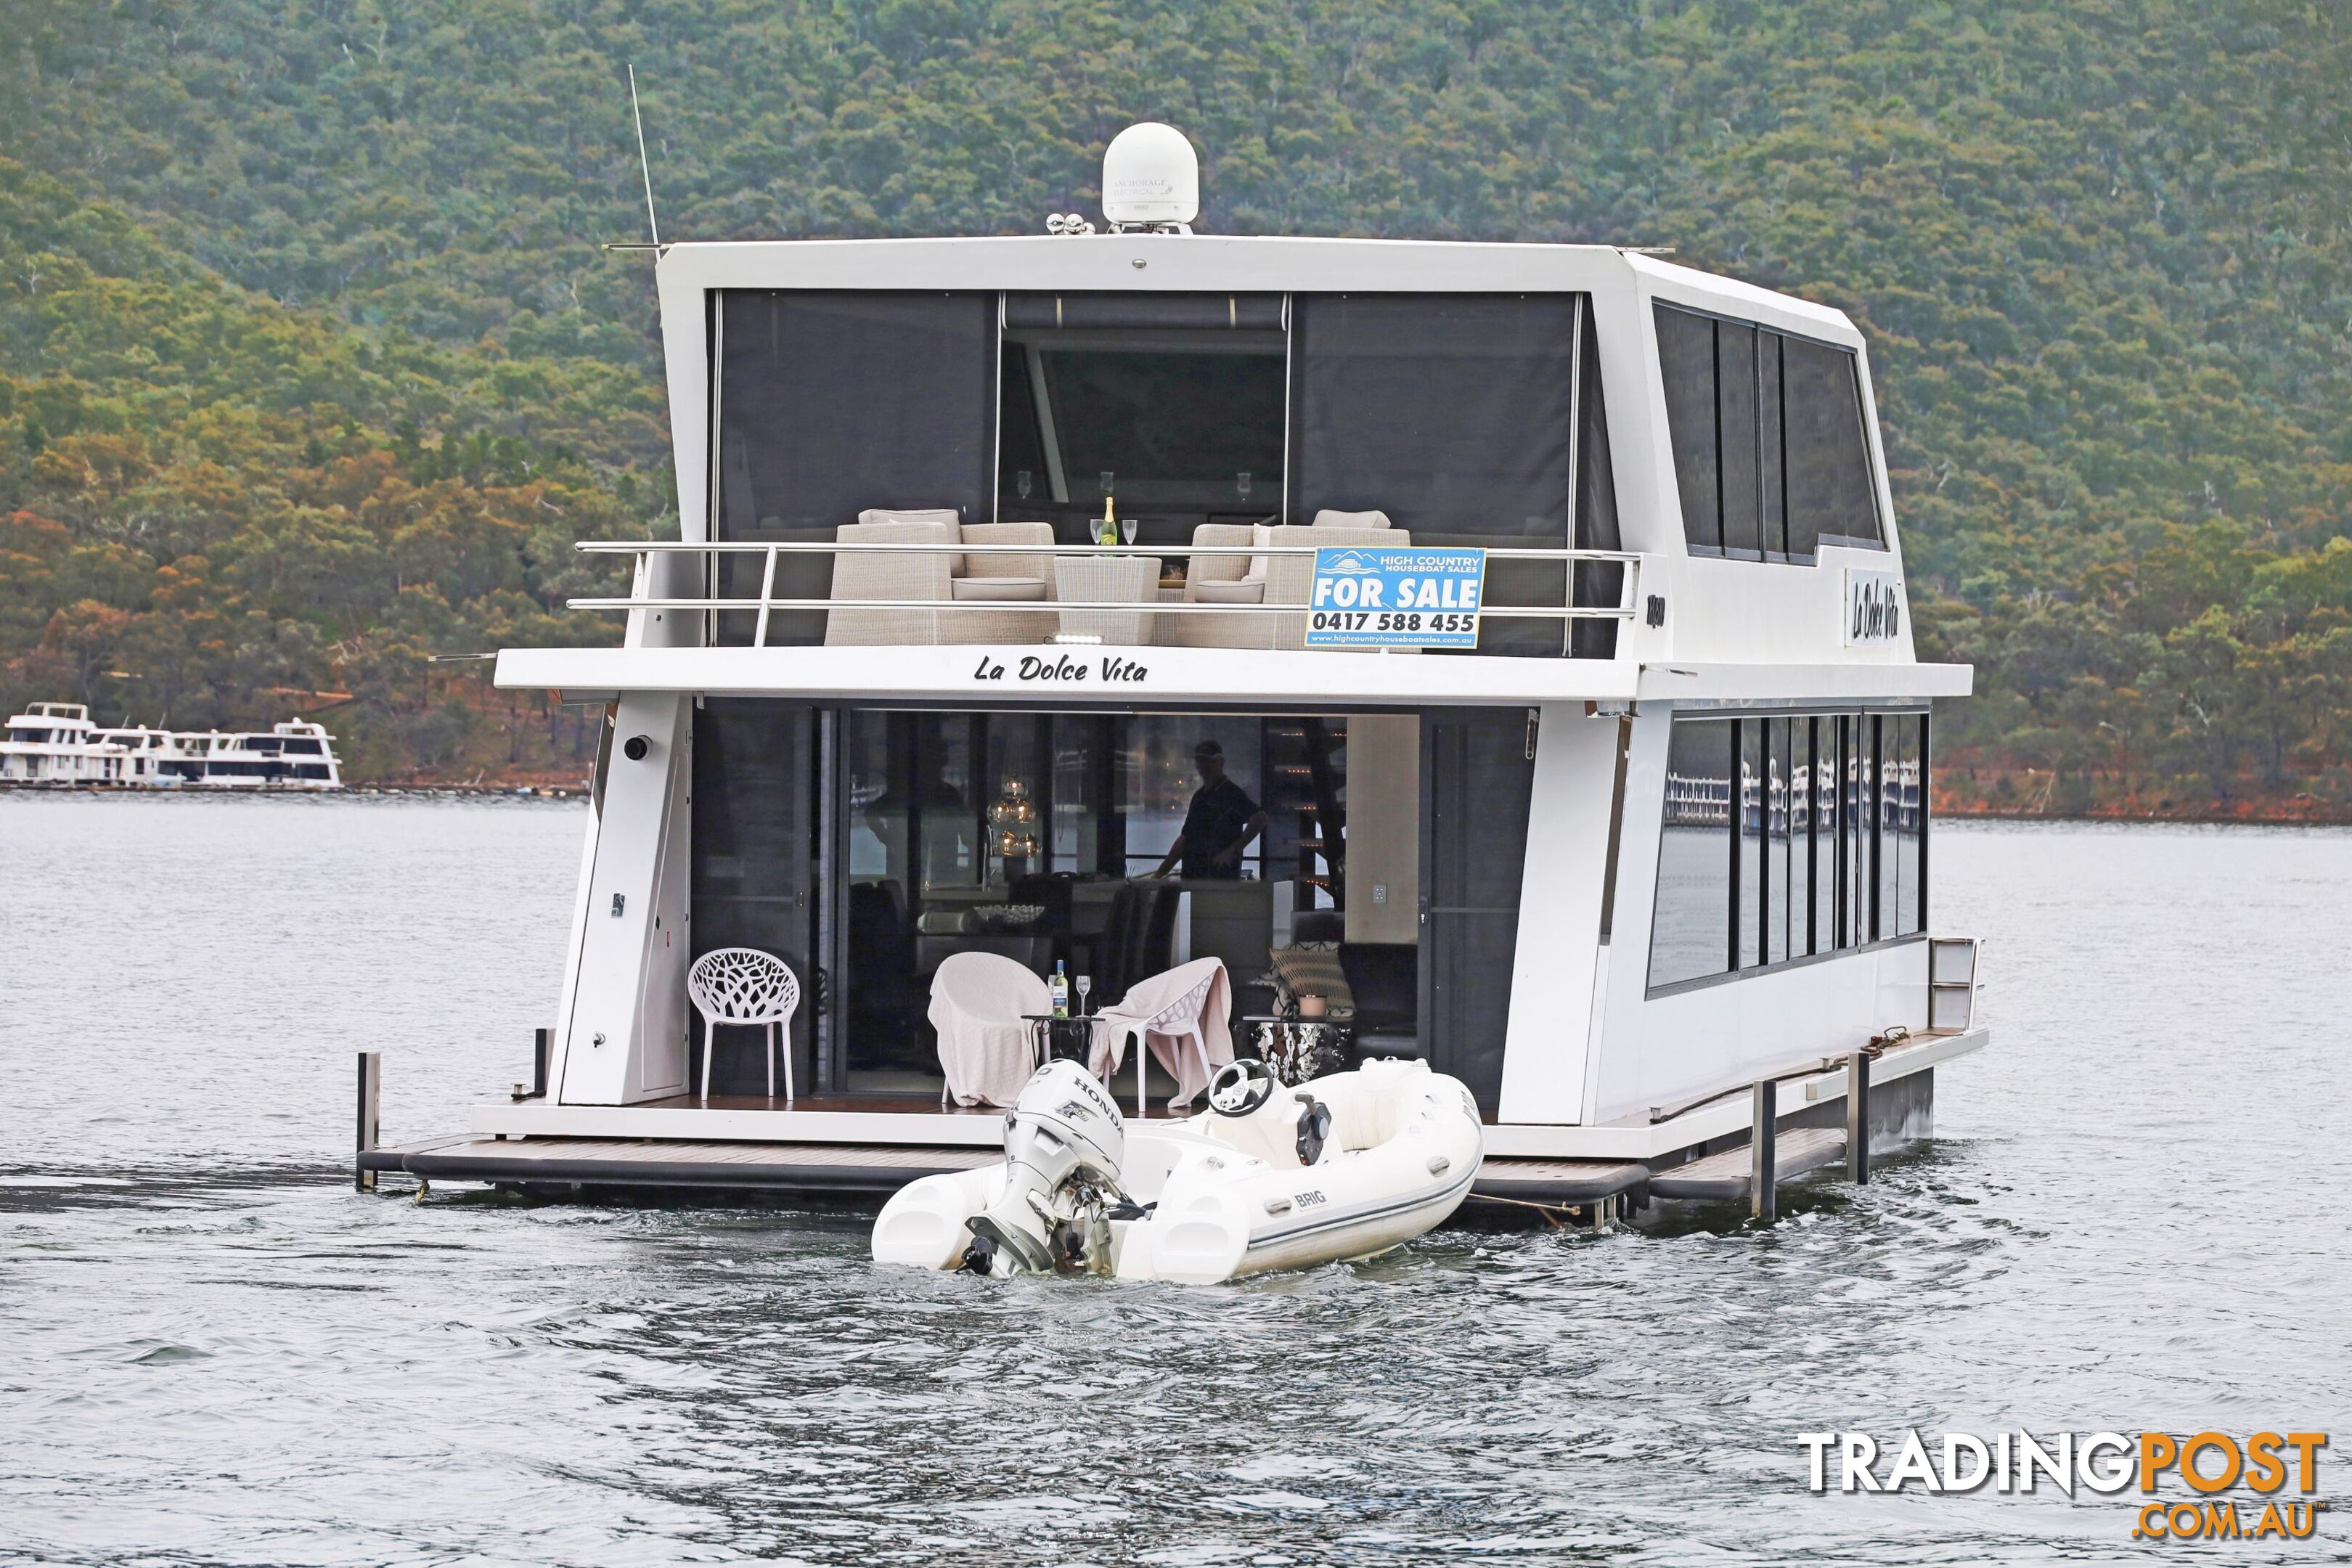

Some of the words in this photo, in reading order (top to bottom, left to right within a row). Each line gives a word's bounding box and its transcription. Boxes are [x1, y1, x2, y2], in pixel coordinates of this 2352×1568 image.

[1380, 555, 1414, 565] HIGH
[1416, 556, 1480, 566] COUNTRY
[1314, 577, 1384, 608] FOR
[1396, 578, 1479, 608] SALE
[1853, 581, 1863, 639] La
[1864, 577, 1883, 639] Dolce
[1885, 584, 1898, 640] Vita
[1312, 612, 1370, 630] 0417
[1377, 613, 1421, 631] 588
[1429, 614, 1474, 632] 455
[1312, 634, 1472, 644] www.highcountryhouseboatsales.com.au
[974, 656, 1005, 679] La
[1018, 654, 1087, 680] Dolce
[1102, 657, 1148, 681] Vita
[1074, 1076, 1124, 1141] HONDA
[1294, 1191, 1327, 1207] BRIG
